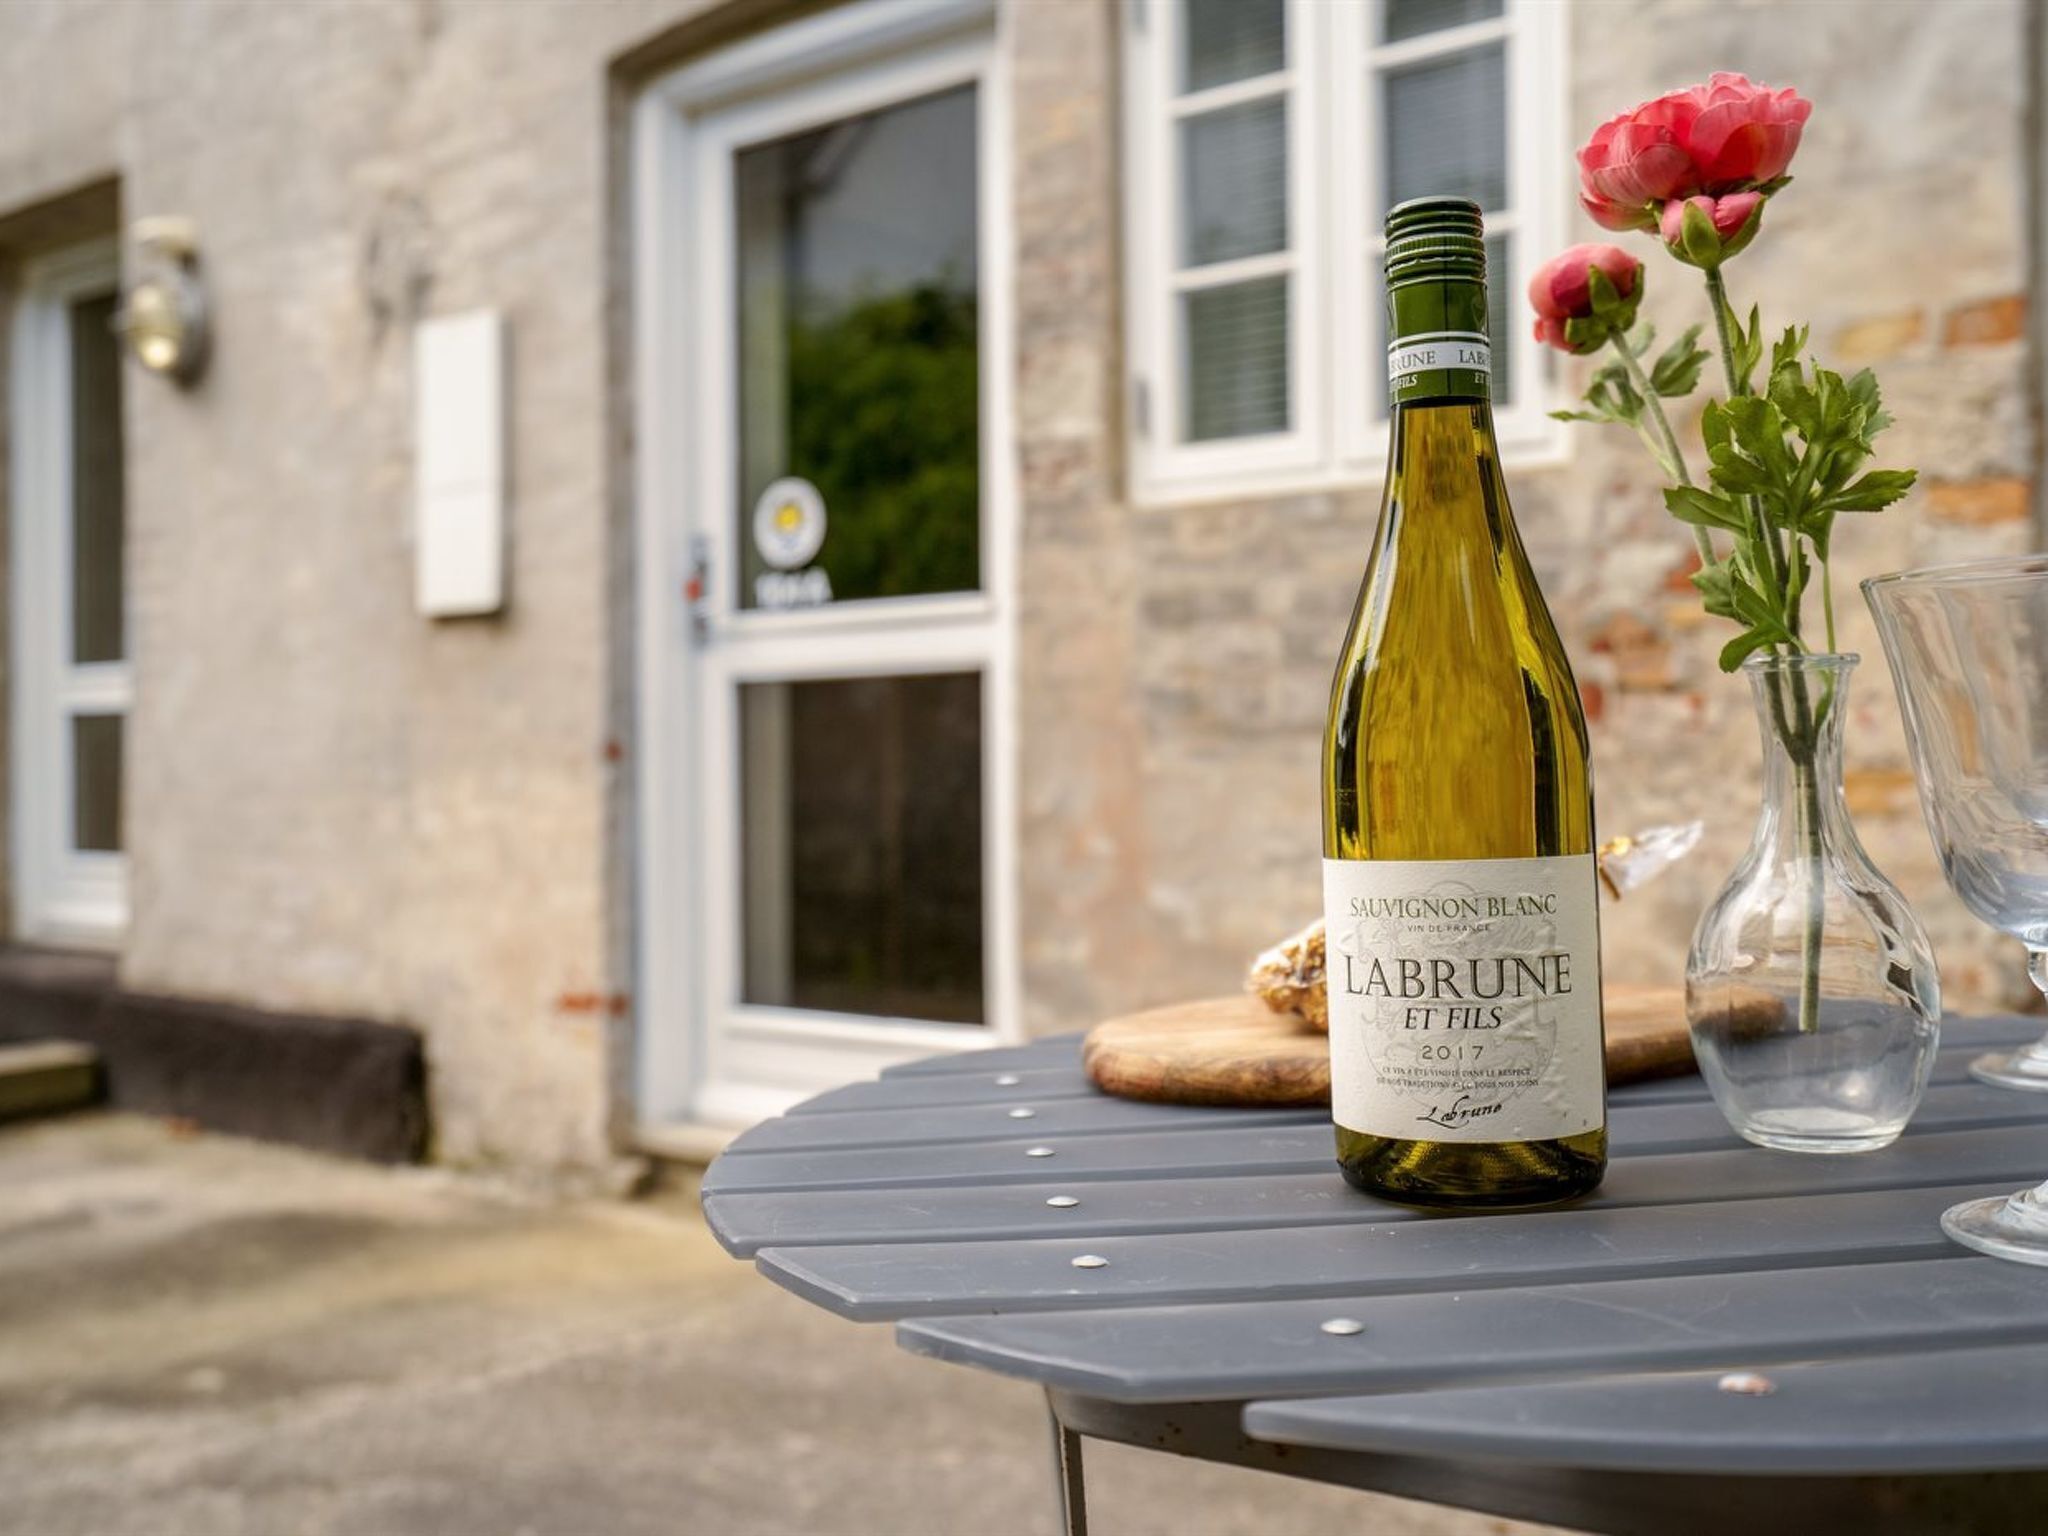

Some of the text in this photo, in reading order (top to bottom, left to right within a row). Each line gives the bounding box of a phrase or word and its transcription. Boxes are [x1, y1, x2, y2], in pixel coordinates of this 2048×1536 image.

[1351, 893, 1557, 918] SAUVIGNON BLANC
[1407, 923, 1491, 932] VIN DE FRANCE
[1345, 953, 1572, 999] LABRUNE
[1404, 1005, 1503, 1030] ET FILS
[1422, 1045, 1484, 1060] 2017
